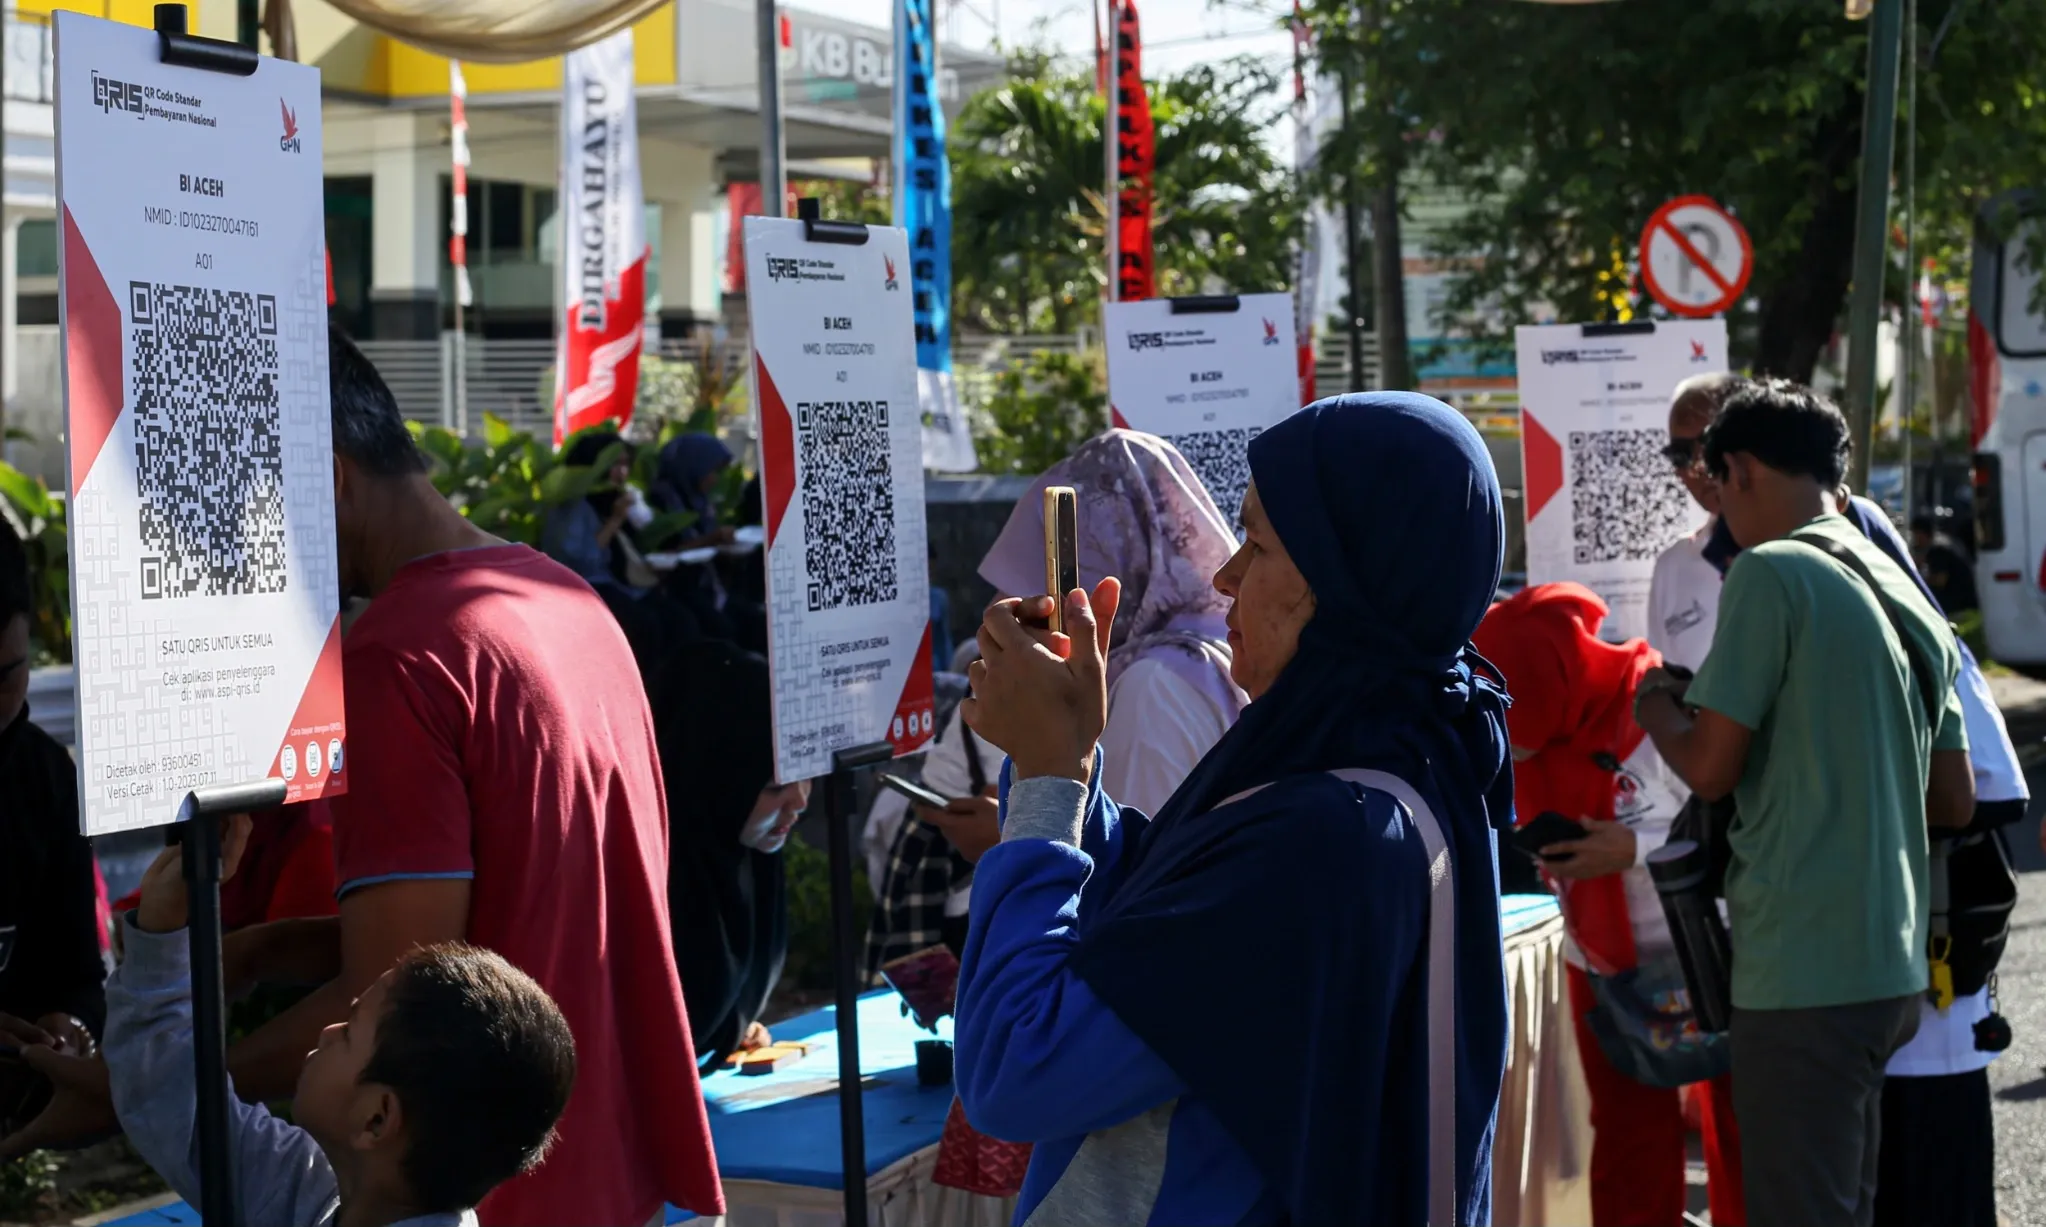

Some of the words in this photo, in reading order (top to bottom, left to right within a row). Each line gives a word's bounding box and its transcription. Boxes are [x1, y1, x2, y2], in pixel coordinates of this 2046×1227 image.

[802, 29, 850, 77] KB
[93, 75, 143, 114] QRIS
[144, 86, 155, 99] QR
[156, 88, 174, 103] Code
[175, 92, 202, 108] Standar
[144, 104, 188, 122] Pembayaran
[188, 113, 217, 128] Nasional
[280, 135, 301, 154] GPN
[179, 173, 191, 192] BI
[193, 176, 224, 198] ACEH
[583, 77, 607, 328] DIRGAHAYU
[144, 206, 172, 225] NMID
[179, 211, 259, 237] ID1023270047161
[195, 253, 213, 270] A01
[824, 316, 832, 330] BI
[833, 316, 853, 330] ACEH
[162, 639, 186, 656] SATU
[187, 637, 210, 655] QRIS
[211, 635, 241, 652] UNTUK
[242, 633, 273, 649] SEMUA
[163, 671, 180, 687] Cek
[181, 667, 214, 685] aplikasi
[216, 664, 276, 684] penyelenggara
[106, 762, 138, 779] Dicetak
[139, 759, 157, 775] oleh
[162, 753, 202, 772] 93600451
[107, 783, 129, 800] Versi
[130, 780, 154, 797] Cetak
